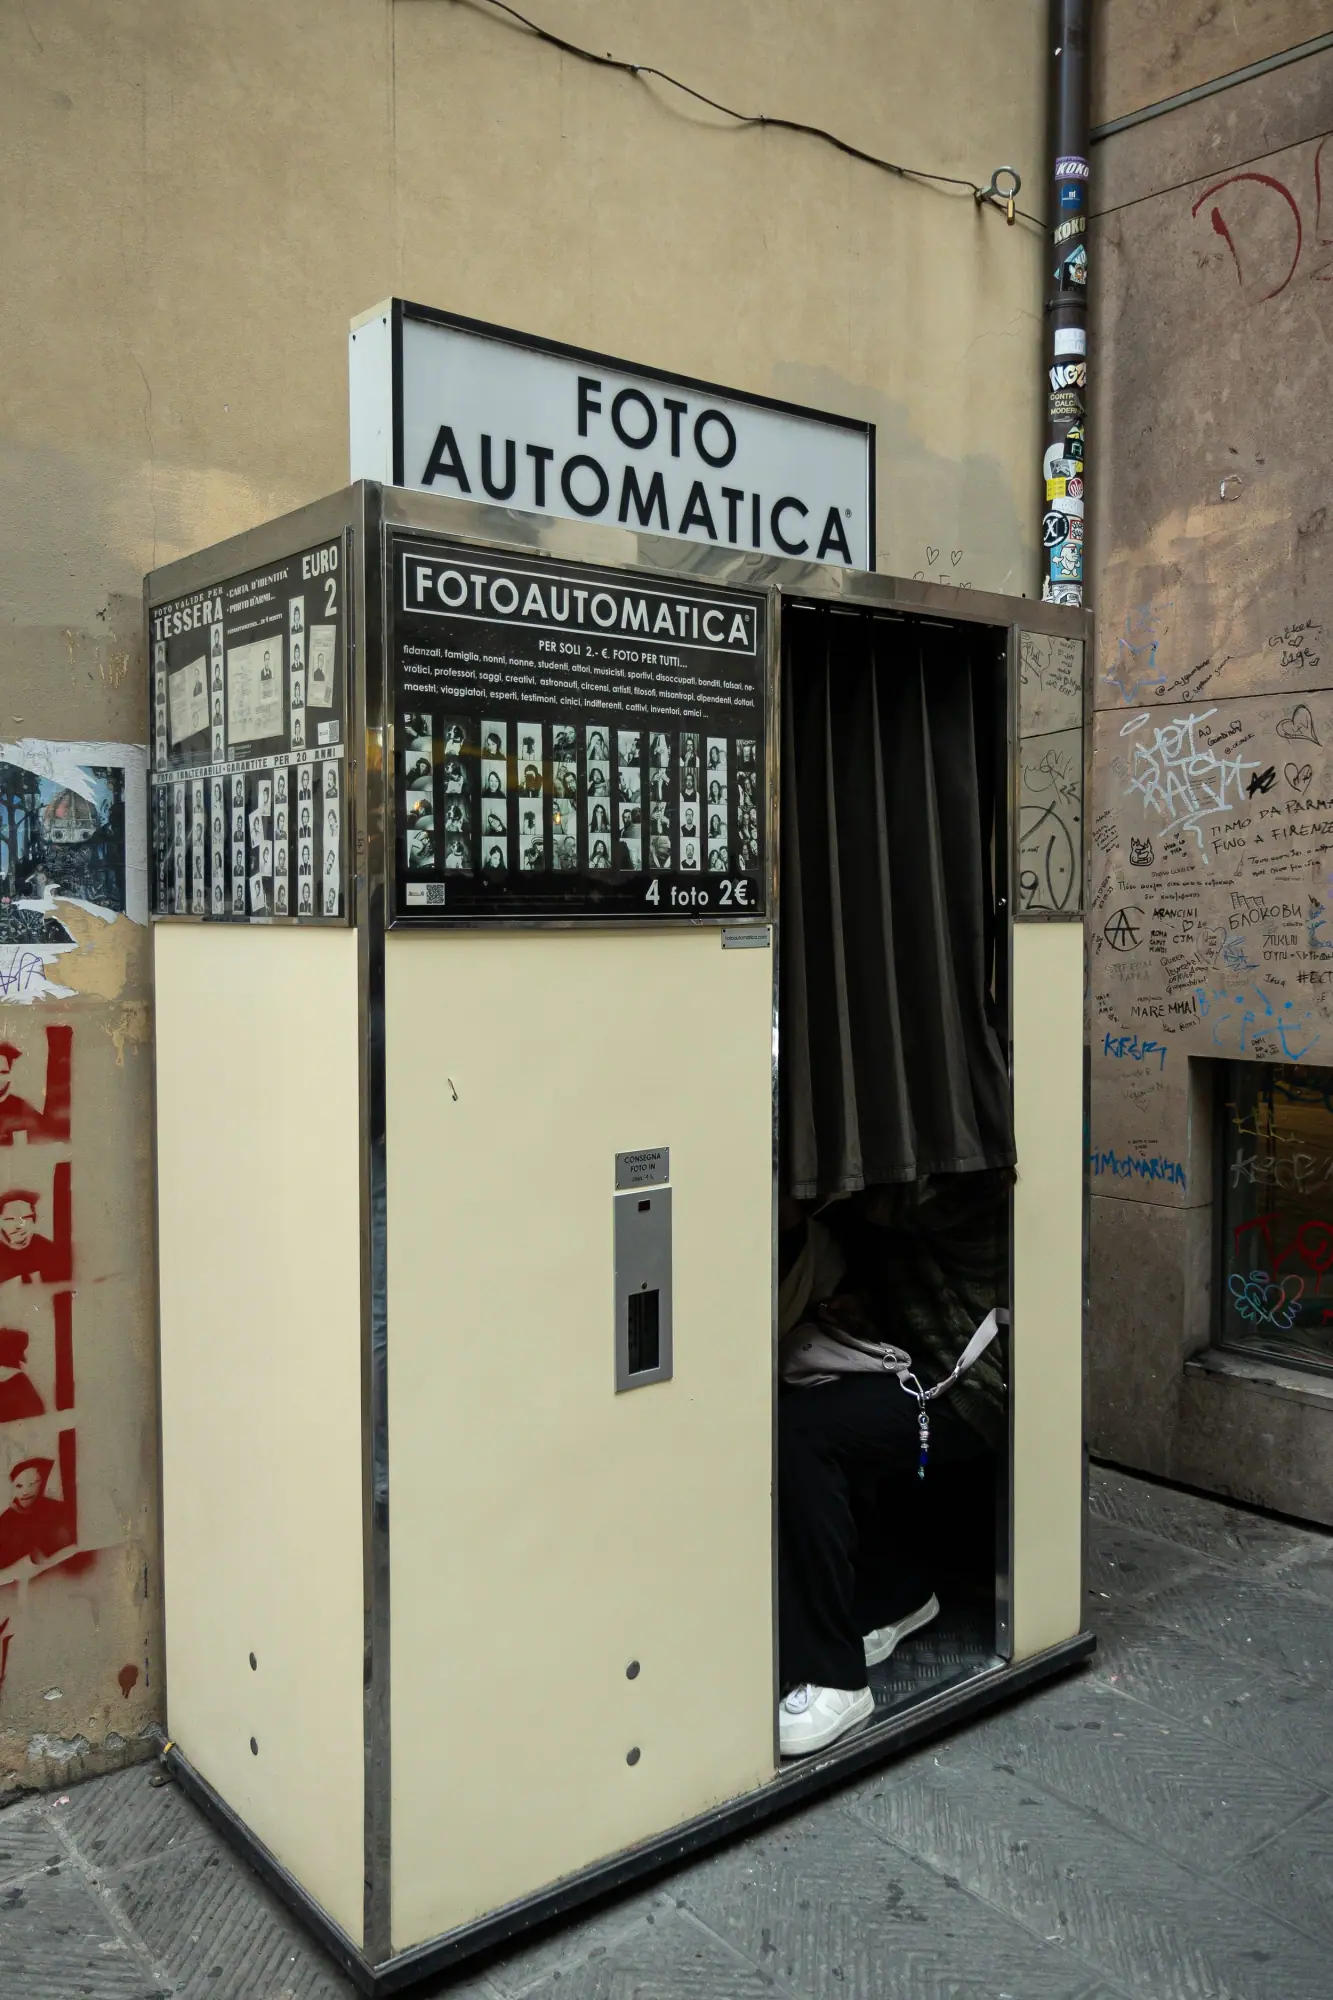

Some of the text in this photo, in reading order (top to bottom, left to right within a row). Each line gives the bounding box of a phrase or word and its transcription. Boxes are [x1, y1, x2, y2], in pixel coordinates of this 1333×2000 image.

[1056, 162, 1089, 177] KOKO
[1054, 217, 1085, 246] KOKO
[577, 376, 737, 469] FOTO
[302, 545, 338, 580] EURO
[153, 586, 224, 618] FOTO VALIDE PER
[229, 583, 249, 599] CARTA
[324, 577, 337, 617] 2
[153, 596, 224, 641] TESSERA
[229, 599, 250, 614] PORTO
[538, 639, 557, 653] PER
[559, 642, 581, 656] SOLI
[613, 649, 639, 663] FOTO
[641, 652, 658, 665] PER
[403, 644, 443, 659] fidanzati,
[444, 649, 482, 662] famiglia,
[482, 654, 507, 666] nonni,
[508, 658, 536, 669] nonne,
[537, 660, 570, 672] studenti,
[571, 664, 593, 675] attori,
[593, 666, 627, 678] musicisti,
[627, 669, 655, 682] sportivi,
[655, 673, 698, 686] disoccupati,
[698, 677, 723, 689] banditi,
[403, 663, 756, 708] vrotici, professori, saggi, creativi, astronauti, circensi, artisti, filosofi, misantropi, dipendenti, dottori,
[440, 686, 488, 699] viaggiatori,
[489, 690, 519, 702] esperti,
[520, 692, 558, 705] testimoni,
[559, 696, 583, 707] cinici,
[584, 698, 624, 711] indifferenti,
[625, 701, 649, 713] cattivi,
[650, 705, 682, 717] inventori,
[157, 772, 174, 784] FOTO
[226, 758, 268, 773] GARANTITE
[273, 753, 290, 765] PER
[296, 751, 308, 763] 20
[314, 747, 337, 759] ANNI
[1225, 818, 1253, 833] AMO
[1259, 806, 1282, 820] DA
[1254, 834, 1264, 844] A
[645, 879, 660, 906] 4
[670, 886, 710, 906] foto
[1152, 907, 1198, 921] ARANCINI
[1228, 903, 1302, 931] БЛОКОВИ
[1150, 930, 1168, 939] ROMA
[624, 1152, 662, 1164] CONSEGNA
[630, 1164, 648, 1173] FOTO
